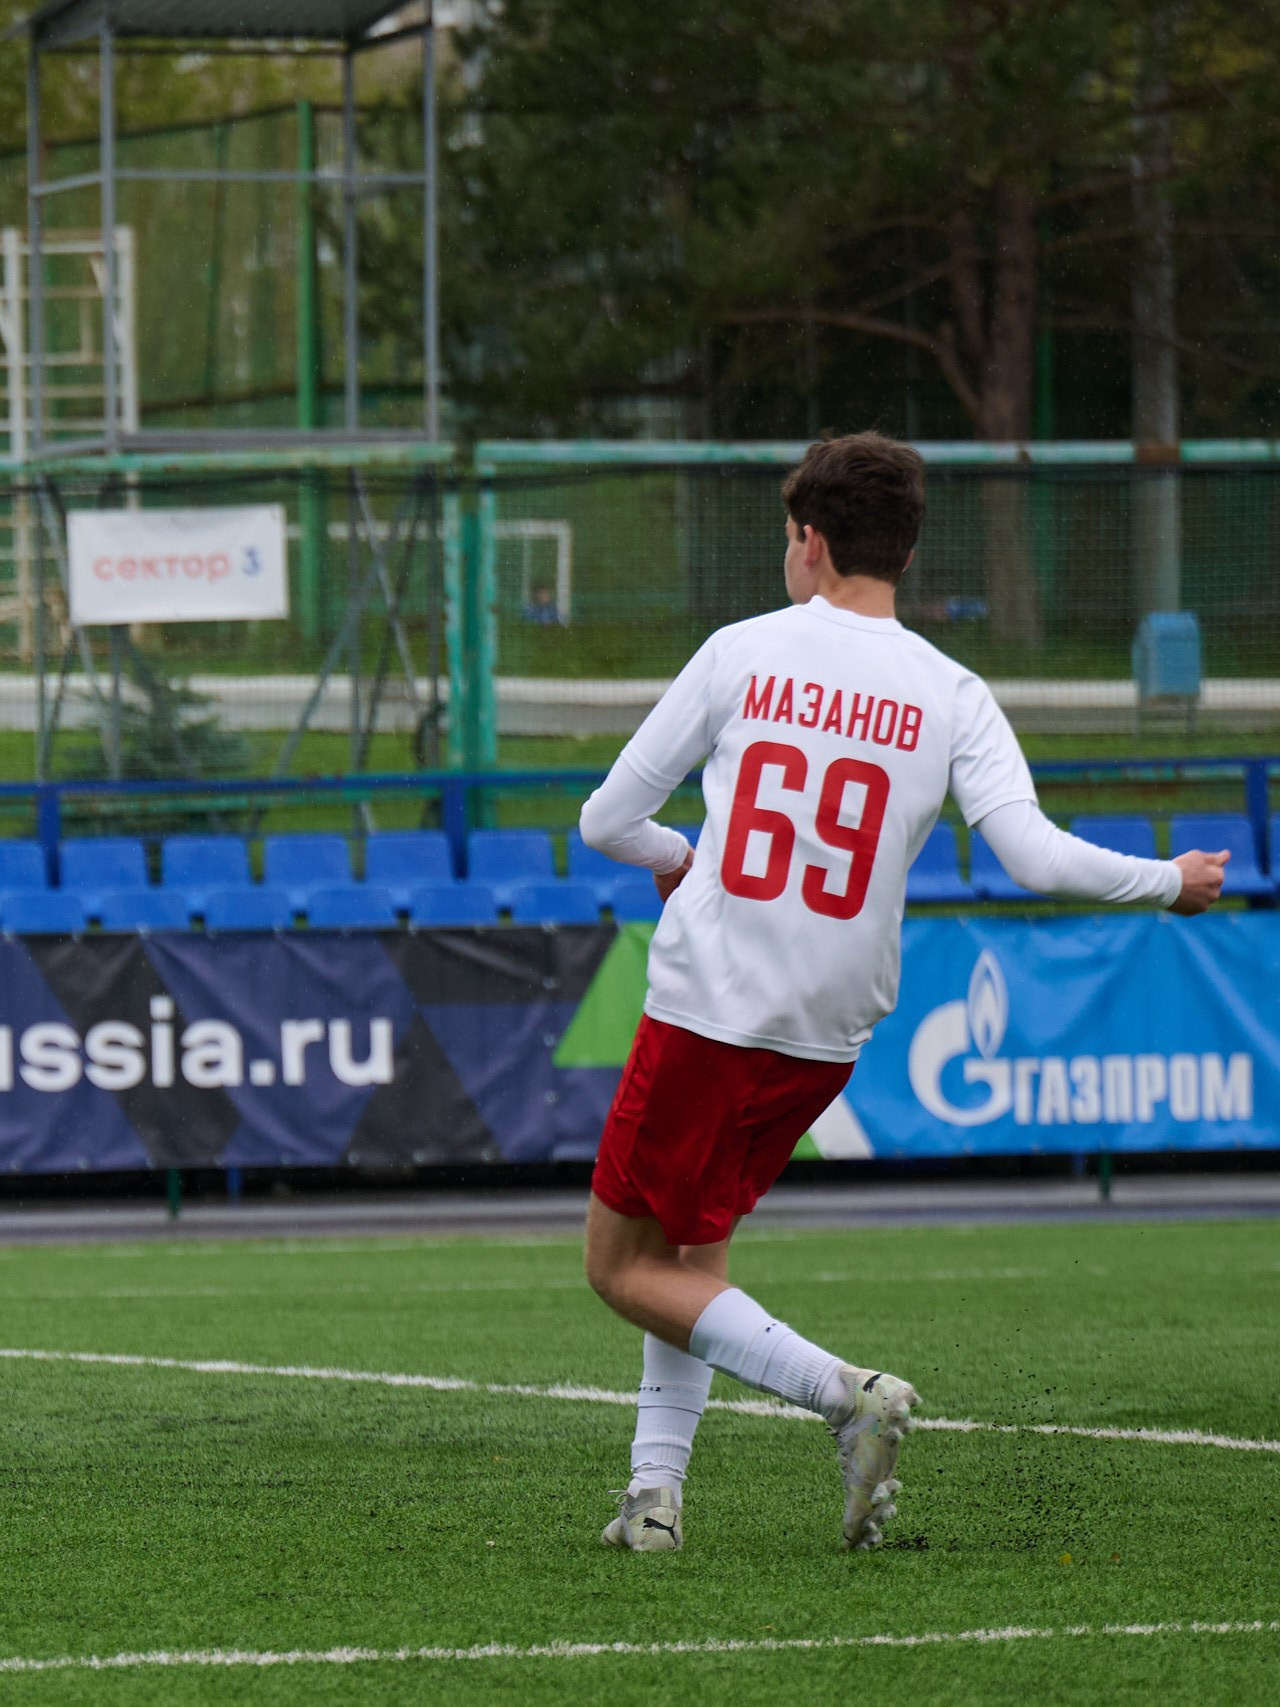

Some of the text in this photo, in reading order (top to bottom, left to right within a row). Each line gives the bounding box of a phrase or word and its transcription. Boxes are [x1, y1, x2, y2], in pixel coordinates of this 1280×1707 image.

[93, 546, 263, 585] сектор 3
[742, 674, 924, 752] МАЗАНОВ
[720, 740, 891, 921] 69
[1014, 1053, 1253, 1125] ГАЗПРОМ
